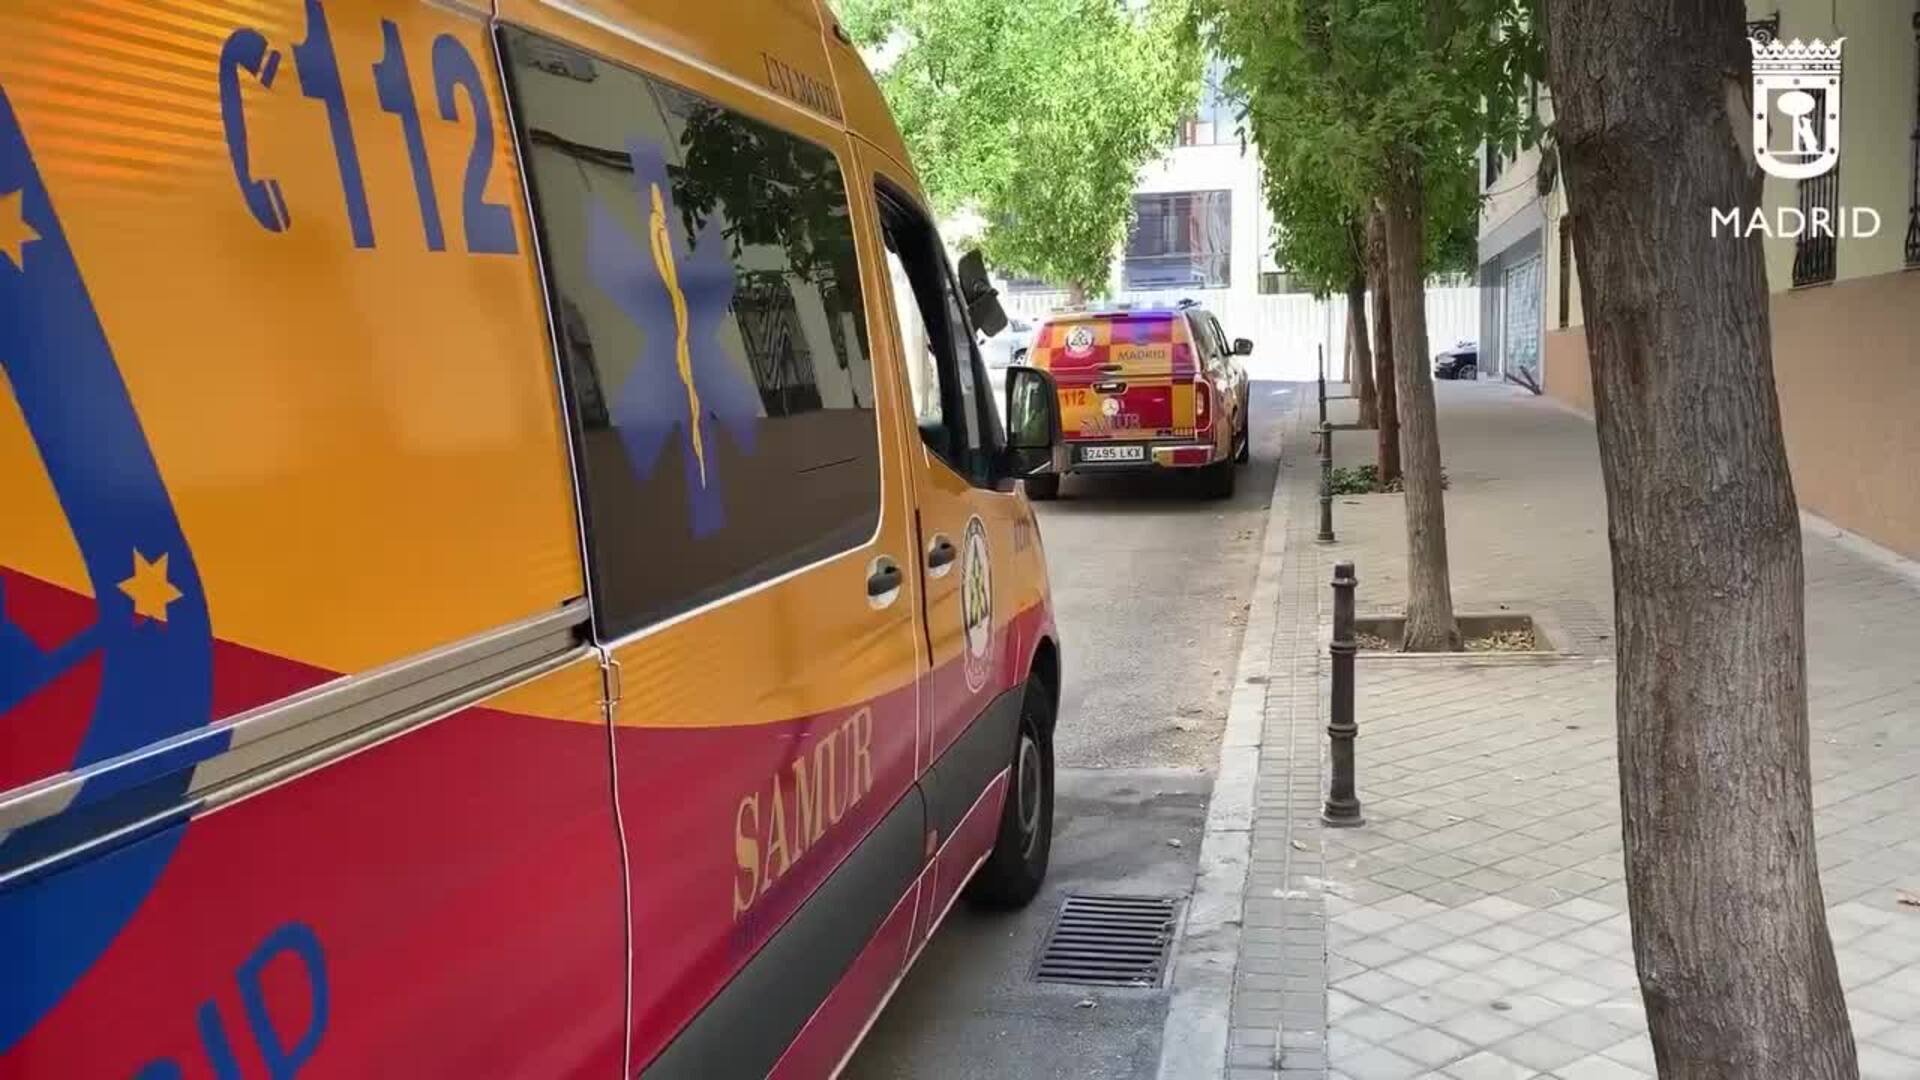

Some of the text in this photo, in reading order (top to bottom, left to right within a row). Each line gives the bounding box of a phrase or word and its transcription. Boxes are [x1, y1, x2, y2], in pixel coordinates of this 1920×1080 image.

[291, 0, 519, 255] 112
[1118, 349, 1166, 361] MADRID
[1062, 390, 1086, 406] 112
[1087, 447, 1141, 459] 2495 LKX
[733, 706, 874, 922] SAMUR
